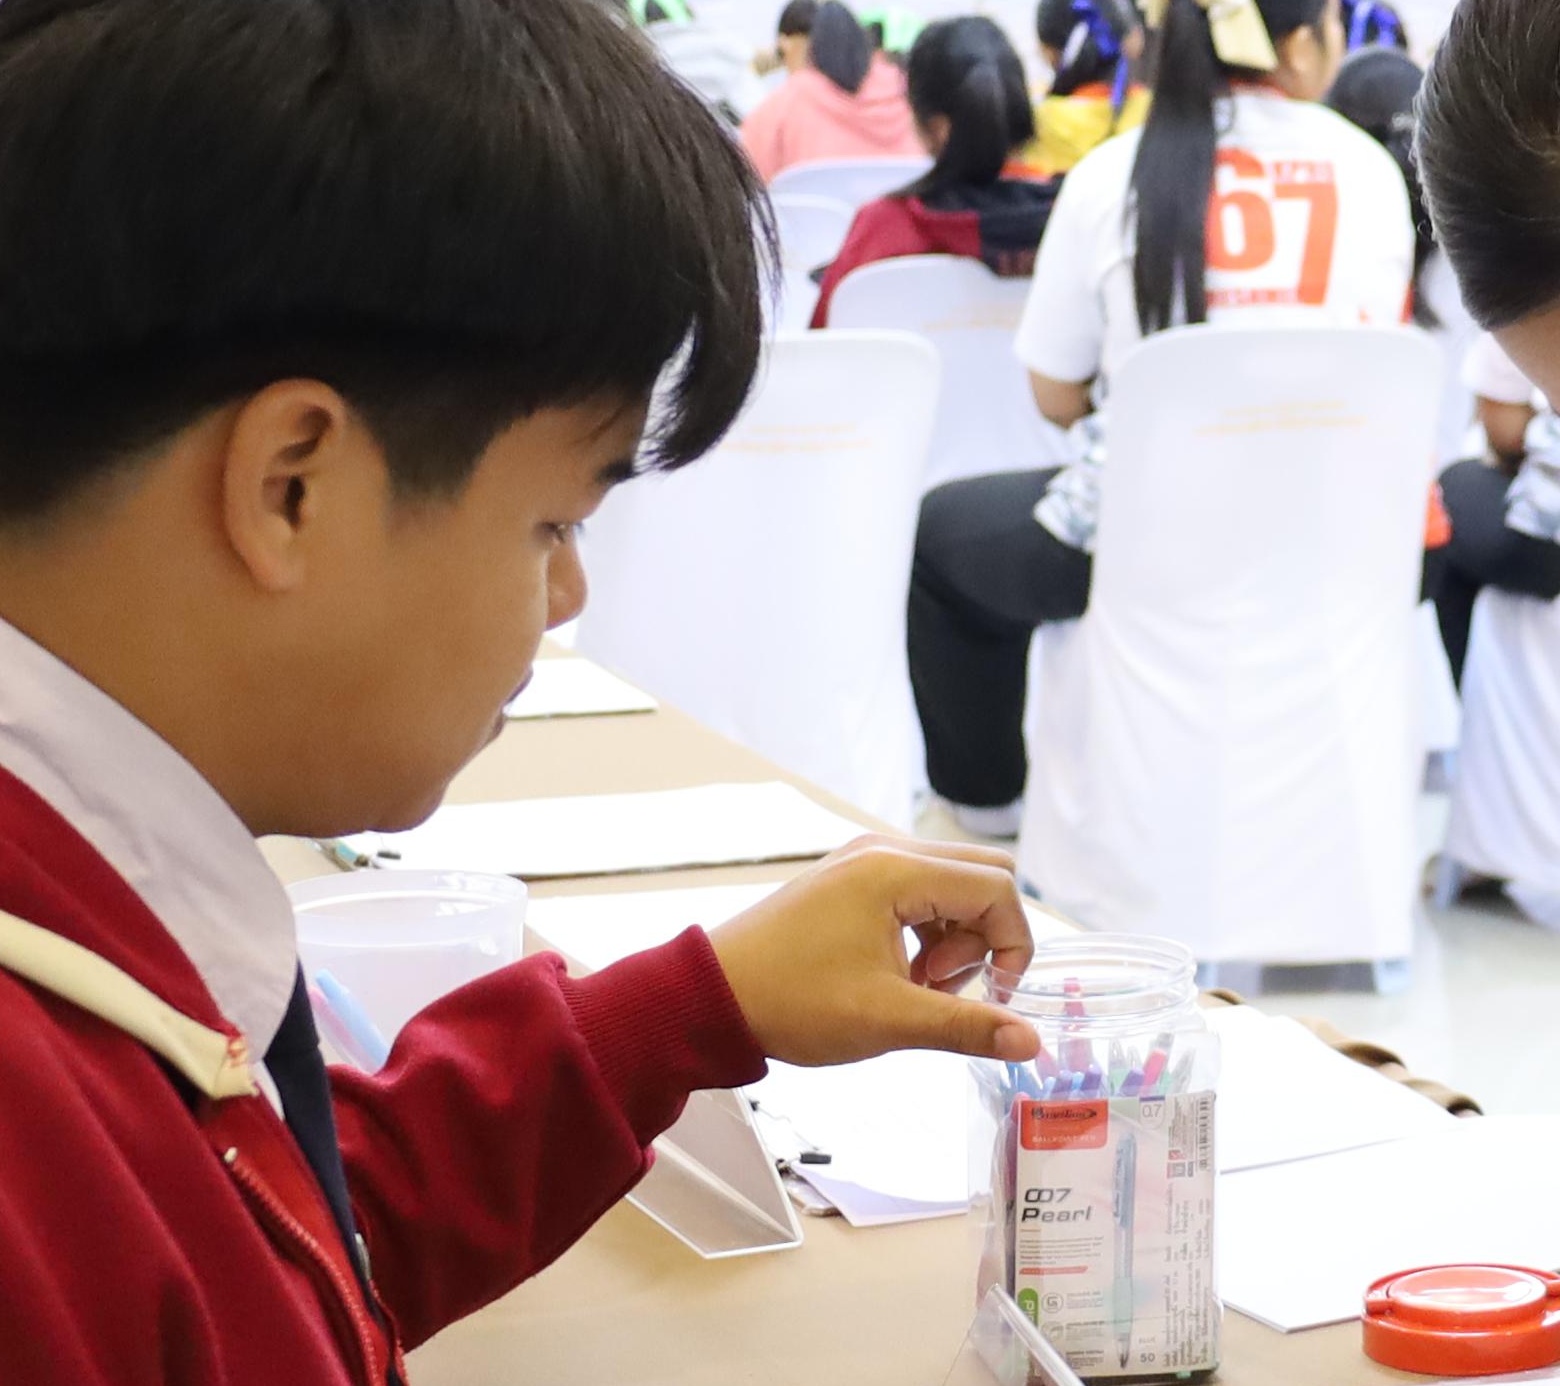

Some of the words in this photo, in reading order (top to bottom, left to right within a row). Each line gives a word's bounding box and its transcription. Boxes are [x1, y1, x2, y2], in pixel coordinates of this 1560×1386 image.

[1204, 148, 1339, 306] 67
[1024, 1188, 1072, 1203] 007
[1021, 1205, 1092, 1222] Pearl
[1140, 1352, 1156, 1363] 50
